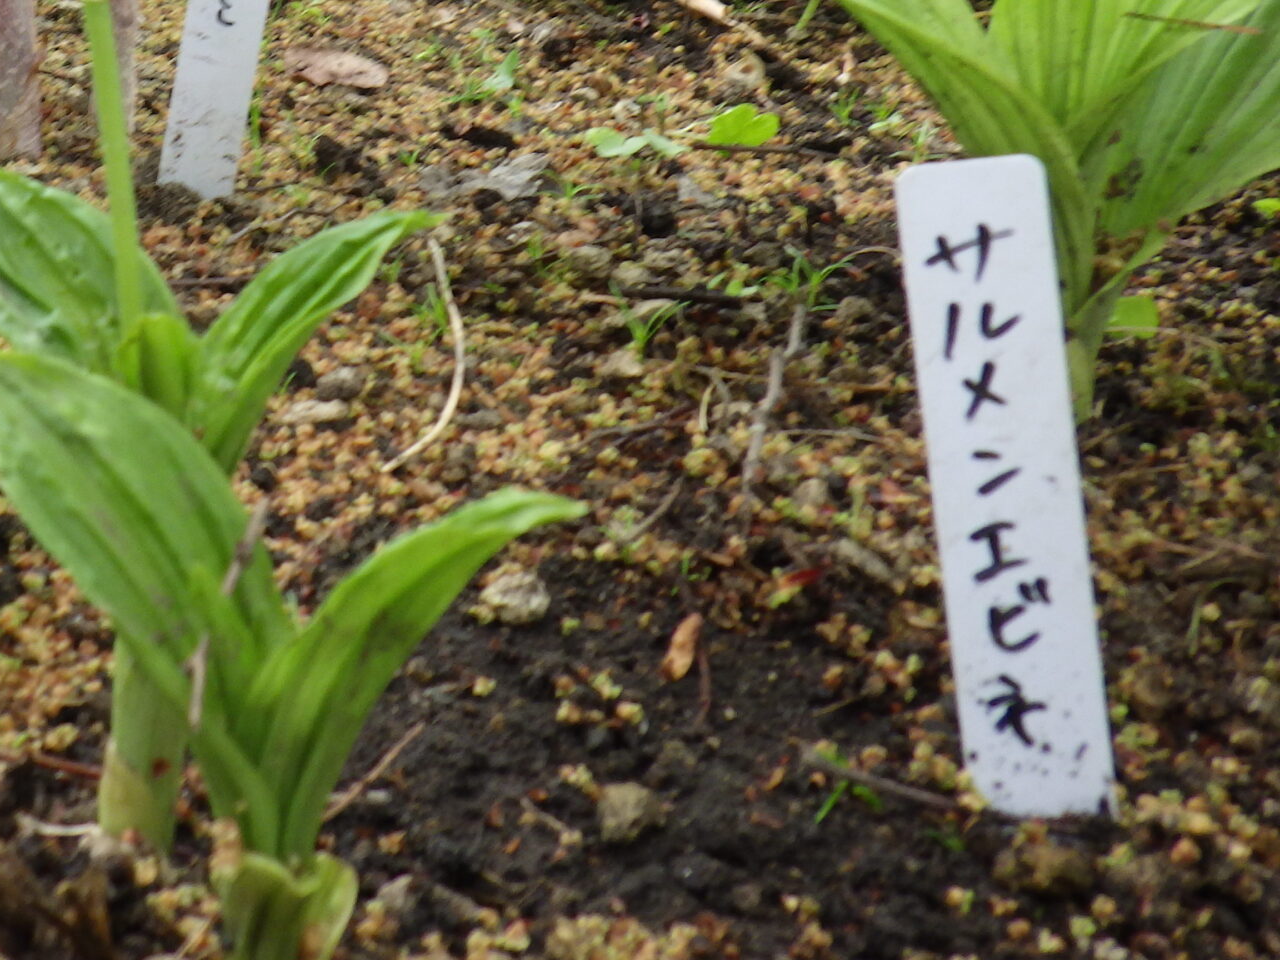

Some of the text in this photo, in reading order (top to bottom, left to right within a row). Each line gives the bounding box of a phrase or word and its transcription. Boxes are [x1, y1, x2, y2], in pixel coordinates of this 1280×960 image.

[924, 222, 1052, 748] サルメンエビネ
